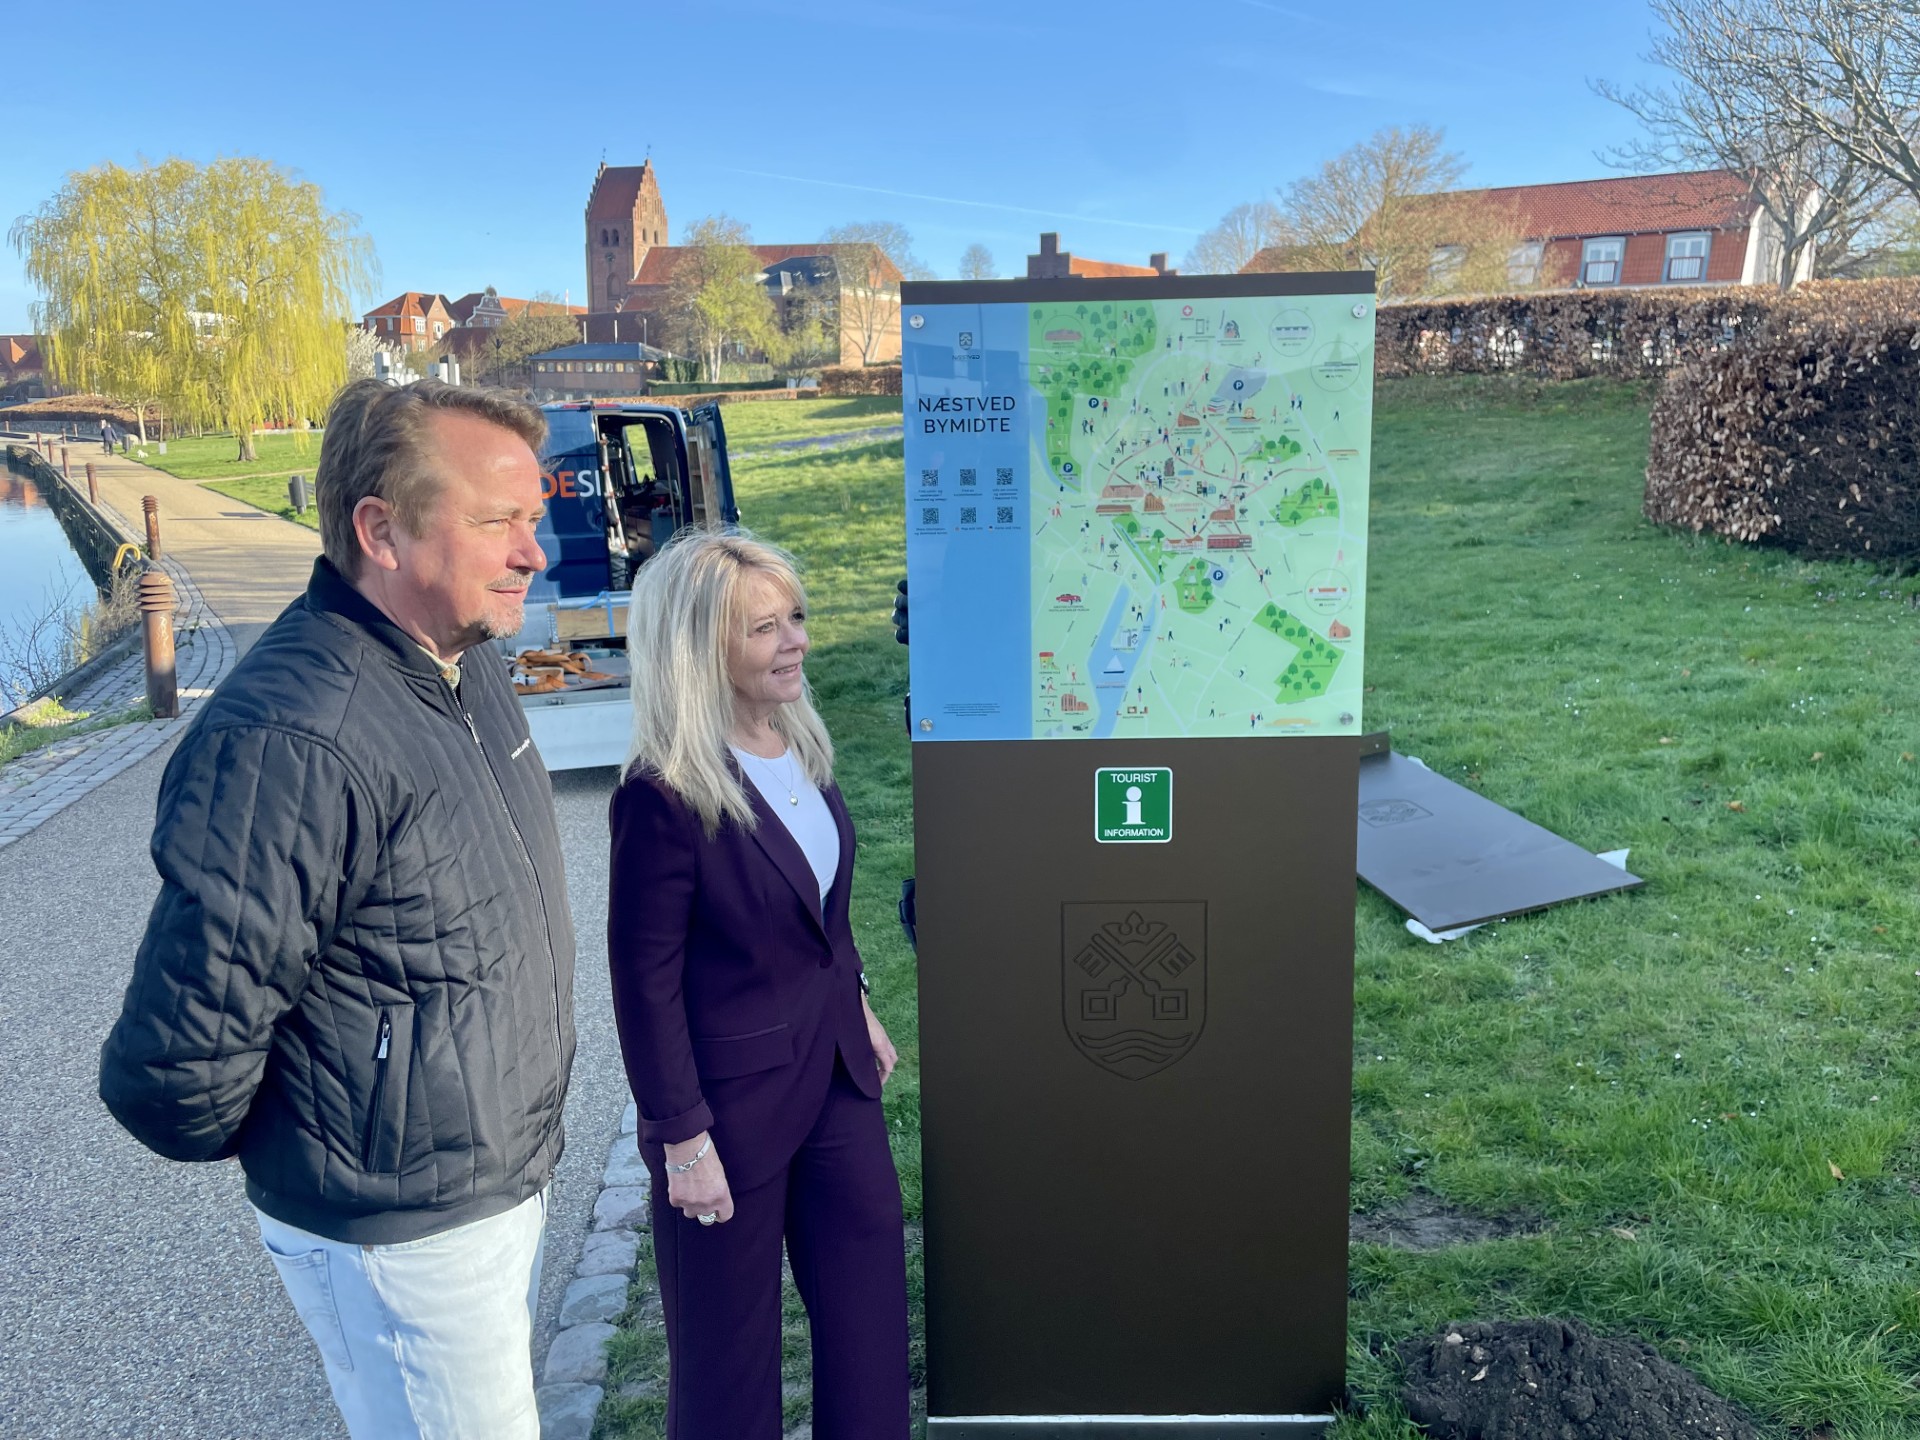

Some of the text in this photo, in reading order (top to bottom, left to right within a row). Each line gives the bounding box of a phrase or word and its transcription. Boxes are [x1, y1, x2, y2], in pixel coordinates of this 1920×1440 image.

[918, 396, 1016, 413] NÆSTVED
[924, 417, 1011, 434] BYMIDTE
[1110, 773, 1157, 783] TOURIST
[1104, 828, 1164, 837] INFORMATION
